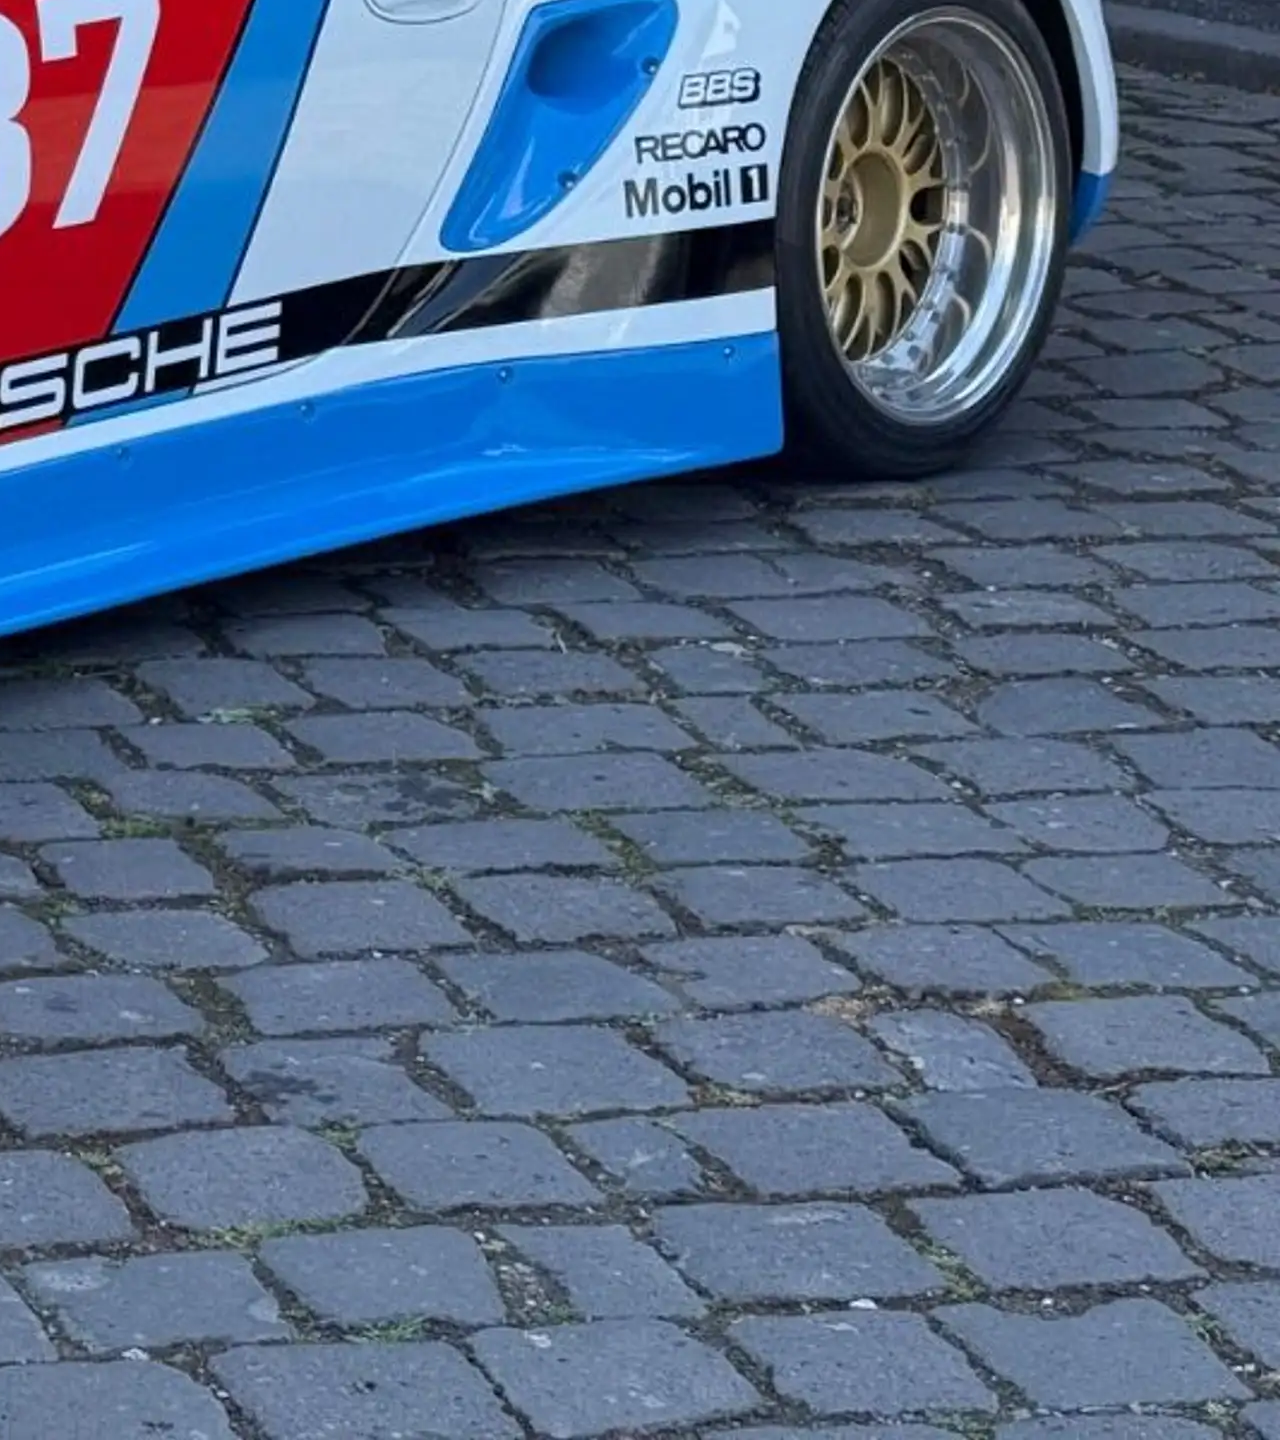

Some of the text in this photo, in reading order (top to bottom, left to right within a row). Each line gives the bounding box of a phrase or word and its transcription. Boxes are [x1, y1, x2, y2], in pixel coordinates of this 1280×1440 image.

[678, 68, 761, 109] BBS
[635, 123, 766, 164] RECARO
[623, 168, 732, 219] Mobil
